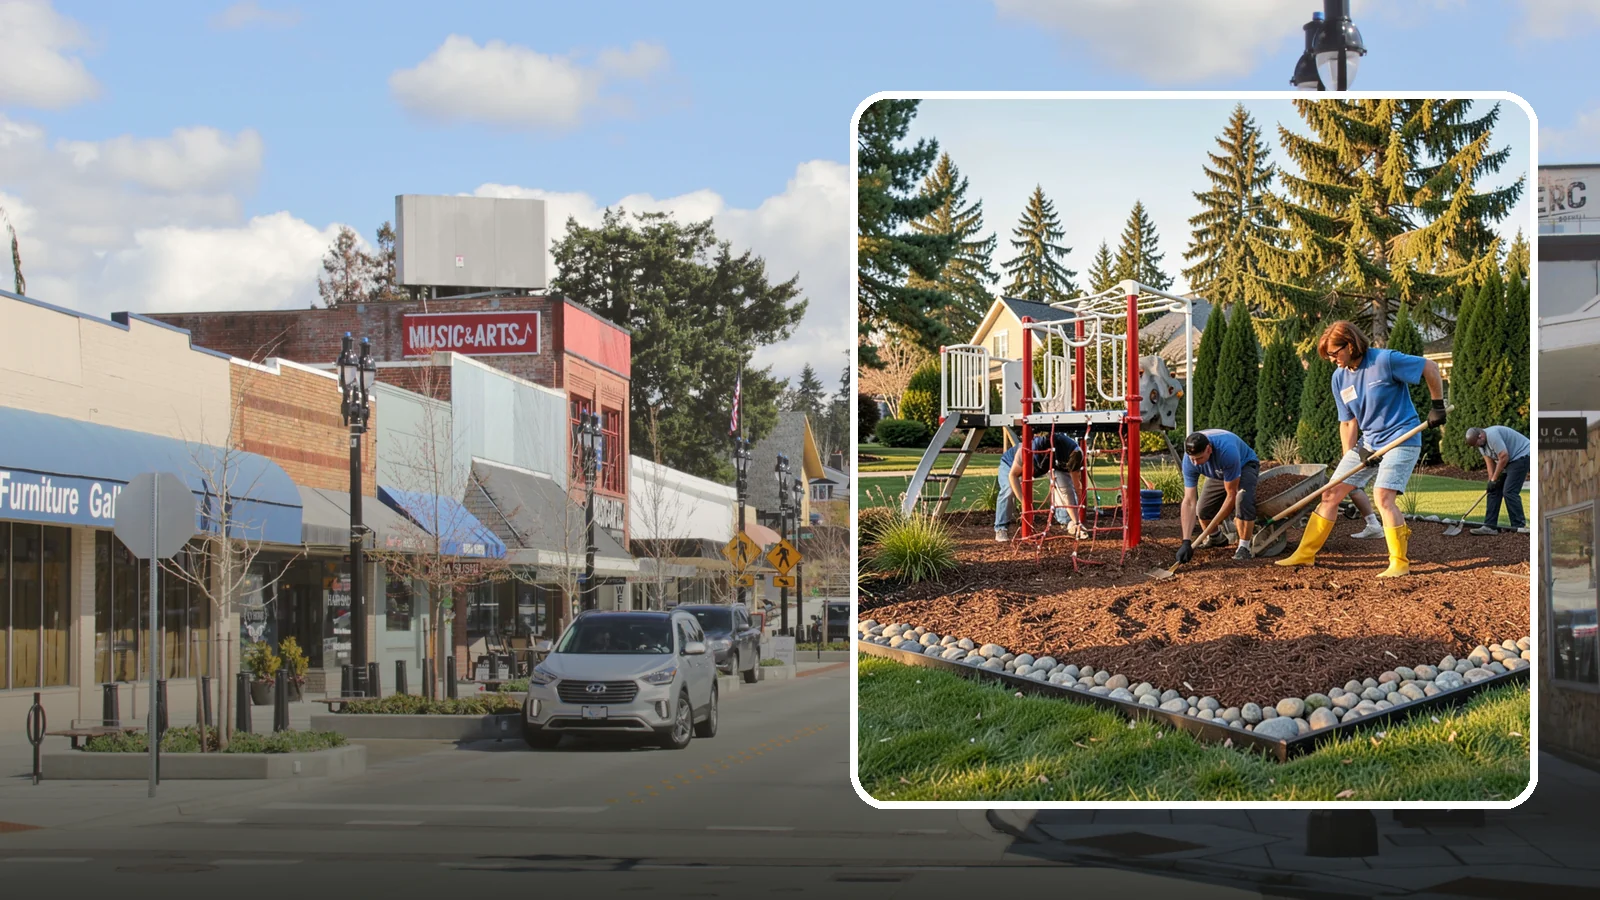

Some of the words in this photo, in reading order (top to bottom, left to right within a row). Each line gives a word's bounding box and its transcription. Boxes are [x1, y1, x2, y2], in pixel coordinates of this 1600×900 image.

[1540, 427, 1577, 436] UGA
[0, 471, 79, 515] Furniture
[89, 482, 121, 519] Gal
[453, 563, 479, 574] SUSHI
